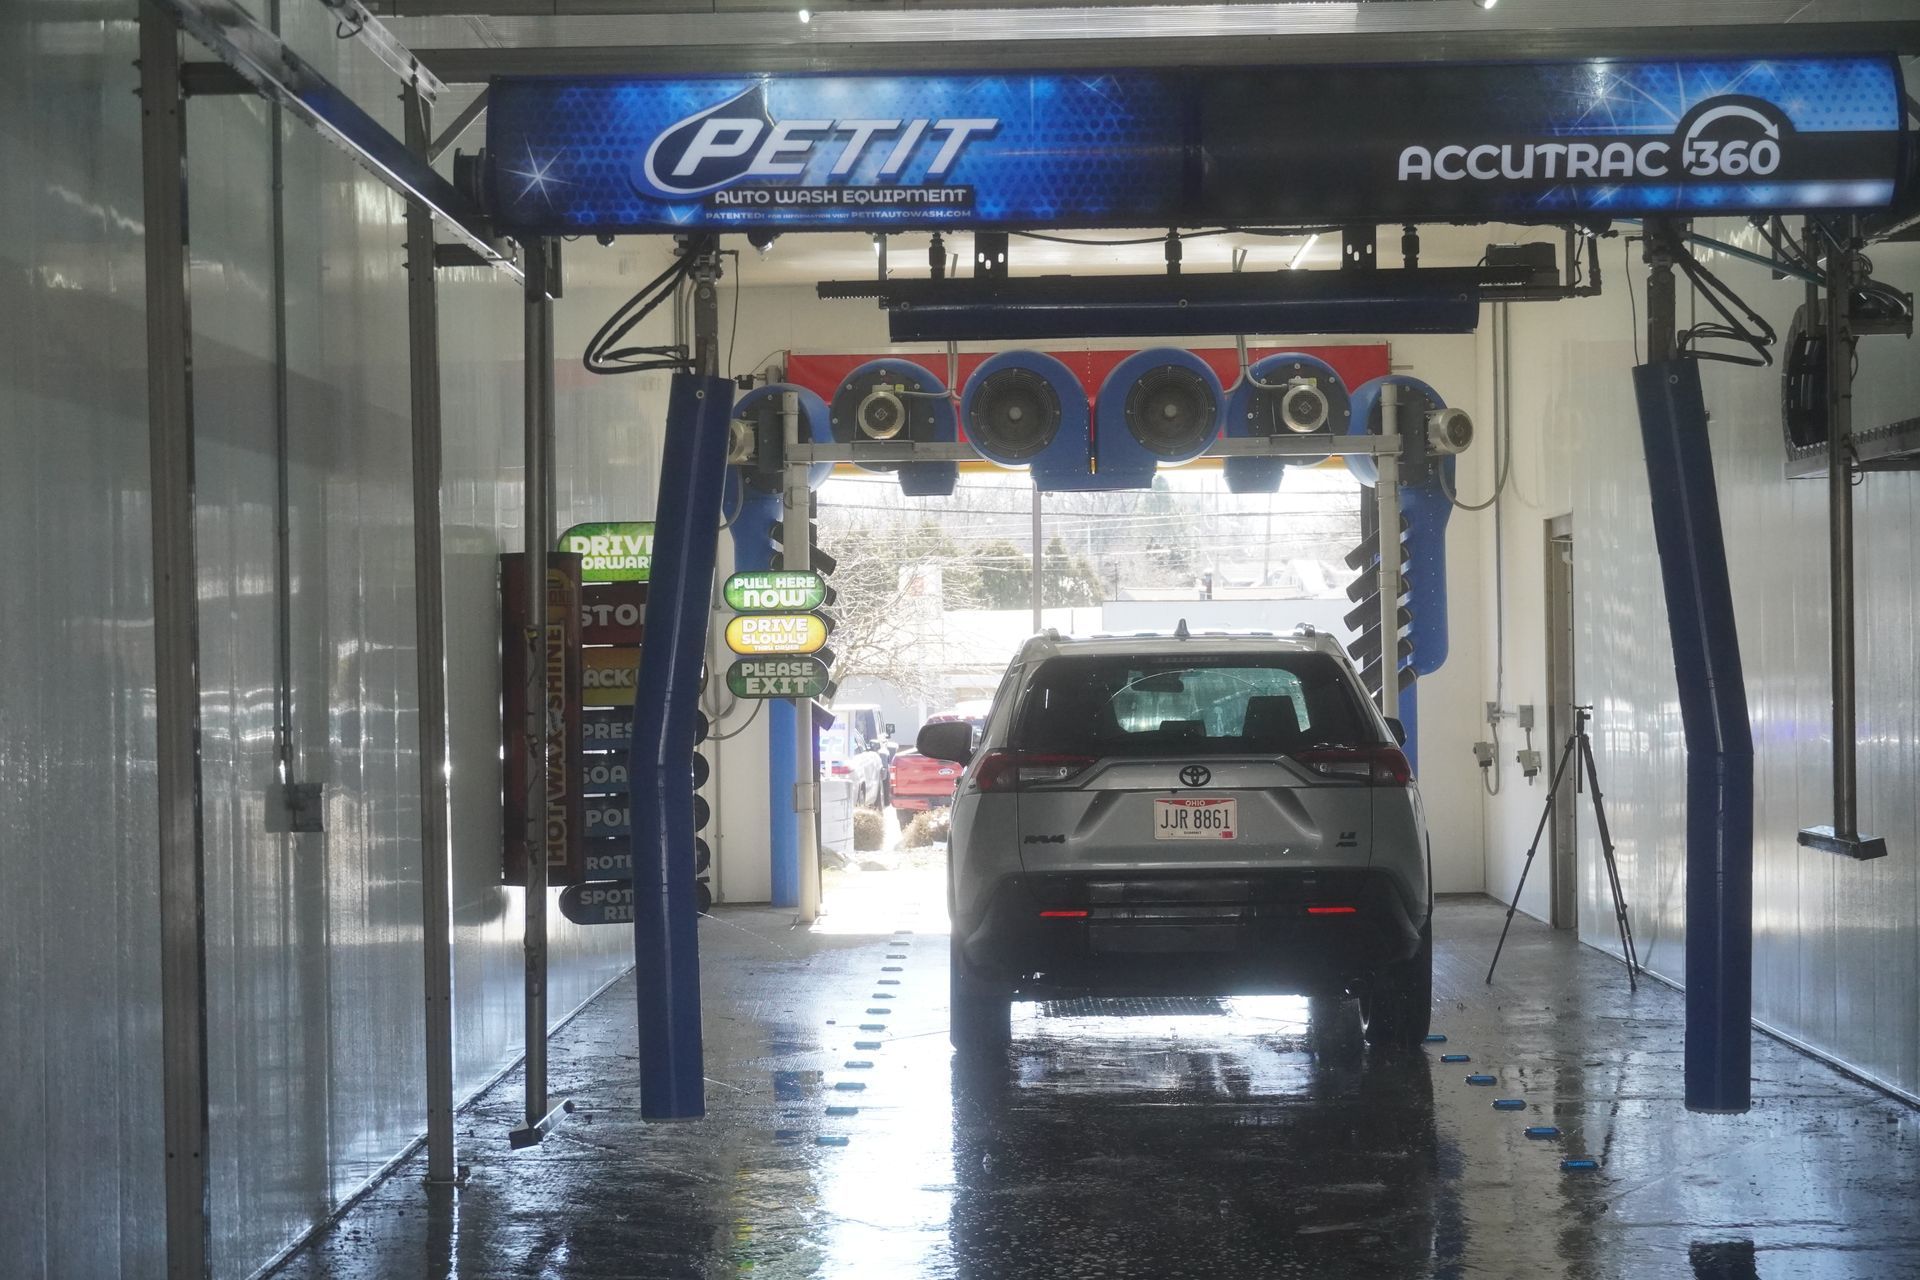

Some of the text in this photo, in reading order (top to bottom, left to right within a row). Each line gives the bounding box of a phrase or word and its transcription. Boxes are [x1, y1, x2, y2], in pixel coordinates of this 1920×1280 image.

[671, 118, 999, 176] PETIT
[1399, 140, 1780, 181] ACCUTRAC 360
[715, 188, 967, 205] AUTO WASH EQUIPMENT
[851, 210, 972, 219] PETITAUTOWASH.COM
[582, 556, 652, 570] ORWAR
[733, 576, 816, 590] PULL HERE
[743, 589, 806, 608] NOW
[742, 618, 808, 633] DRIVE
[741, 633, 808, 645] SLOWLY
[547, 627, 566, 711] SHINE
[583, 669, 632, 688] ACK
[741, 662, 814, 677] PLEASE
[746, 677, 809, 695] EXIT
[547, 729, 566, 800] WAX
[583, 765, 628, 784] SOA
[1160, 808, 1230, 829] JJR 8861
[547, 803, 566, 865] HOT
